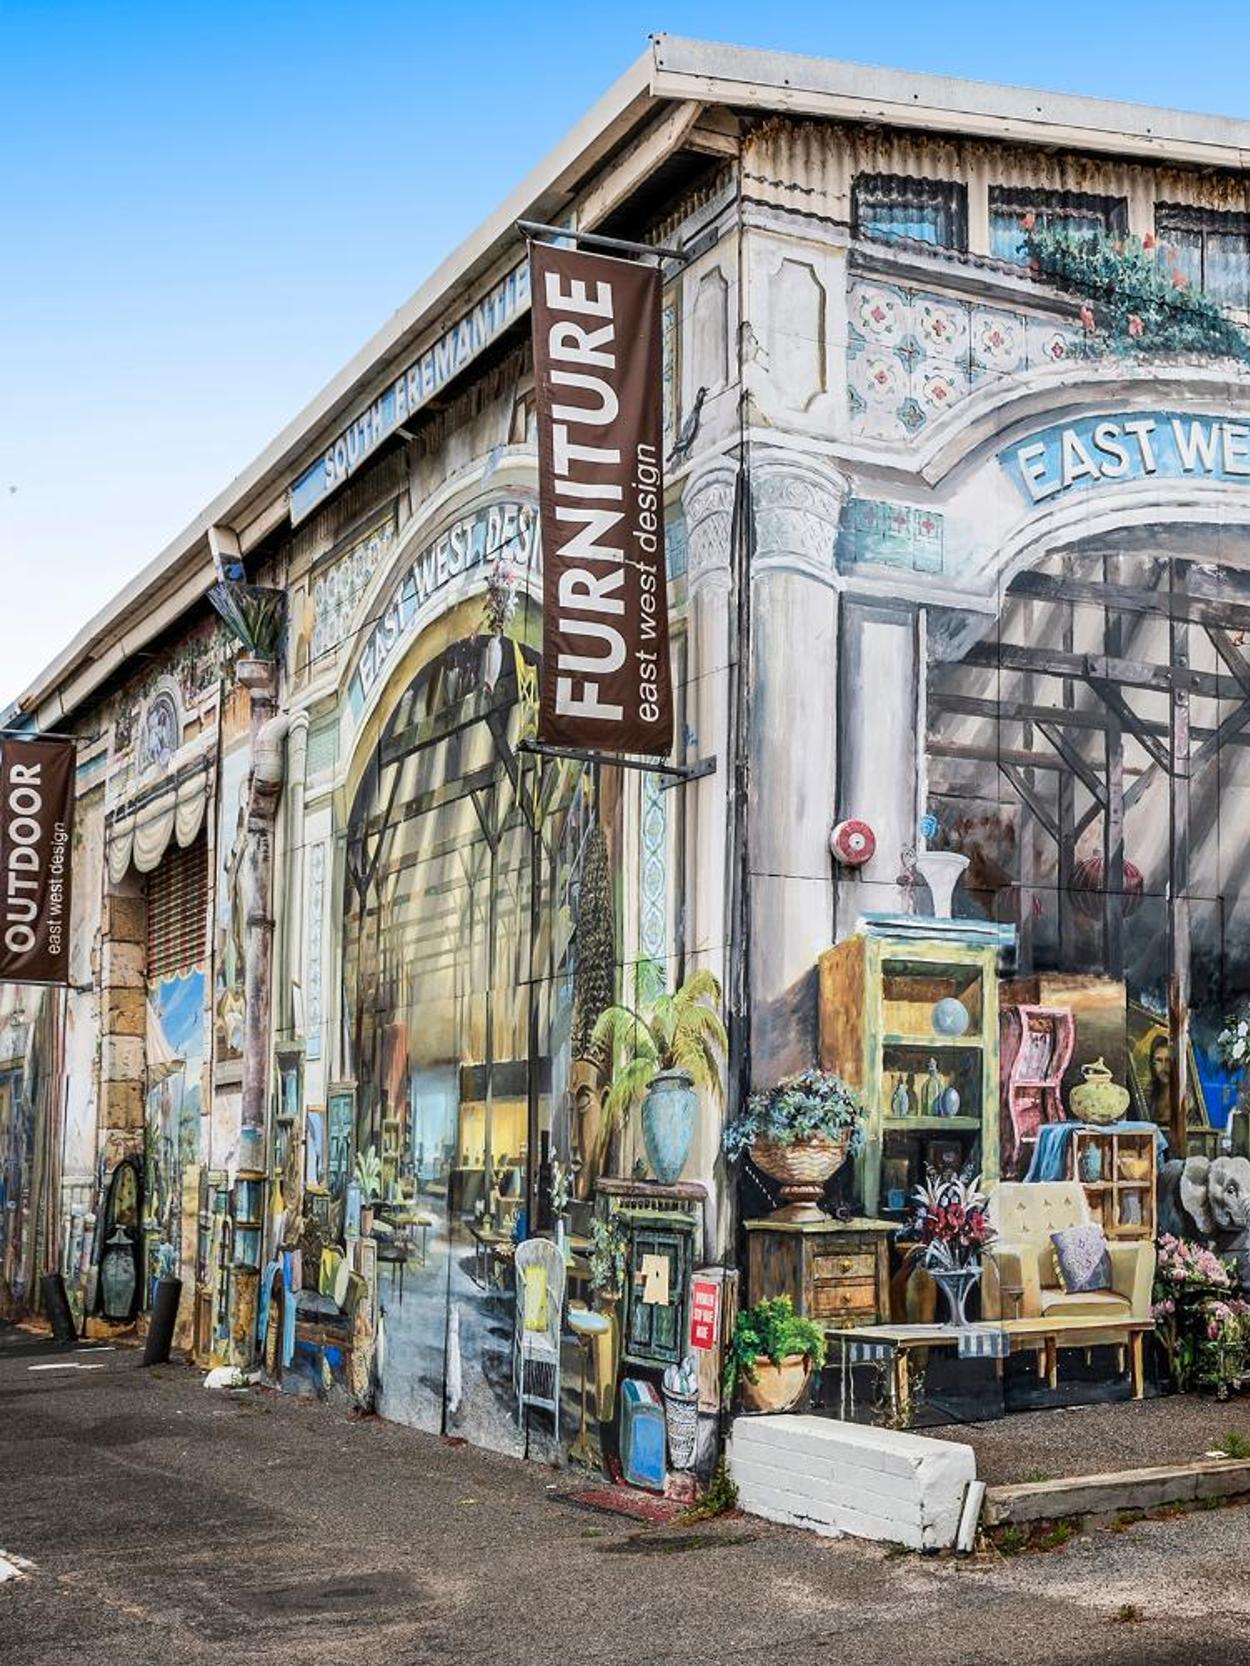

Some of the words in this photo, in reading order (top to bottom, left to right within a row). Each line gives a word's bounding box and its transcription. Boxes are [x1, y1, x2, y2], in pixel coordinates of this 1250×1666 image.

[324, 397, 383, 490] SOUTH
[1016, 419, 1157, 505] EAST
[545, 271, 627, 722] FURNITURE
[632, 443, 661, 553] design
[359, 580, 405, 697] EAST
[413, 514, 478, 606] WEST
[485, 504, 544, 574] DESI
[637, 560, 657, 641] west
[635, 650, 659, 723] east
[4, 763, 42, 953] OUTDOOR
[50, 822, 69, 874] design
[47, 920, 62, 954] east
[49, 878, 63, 917] west
